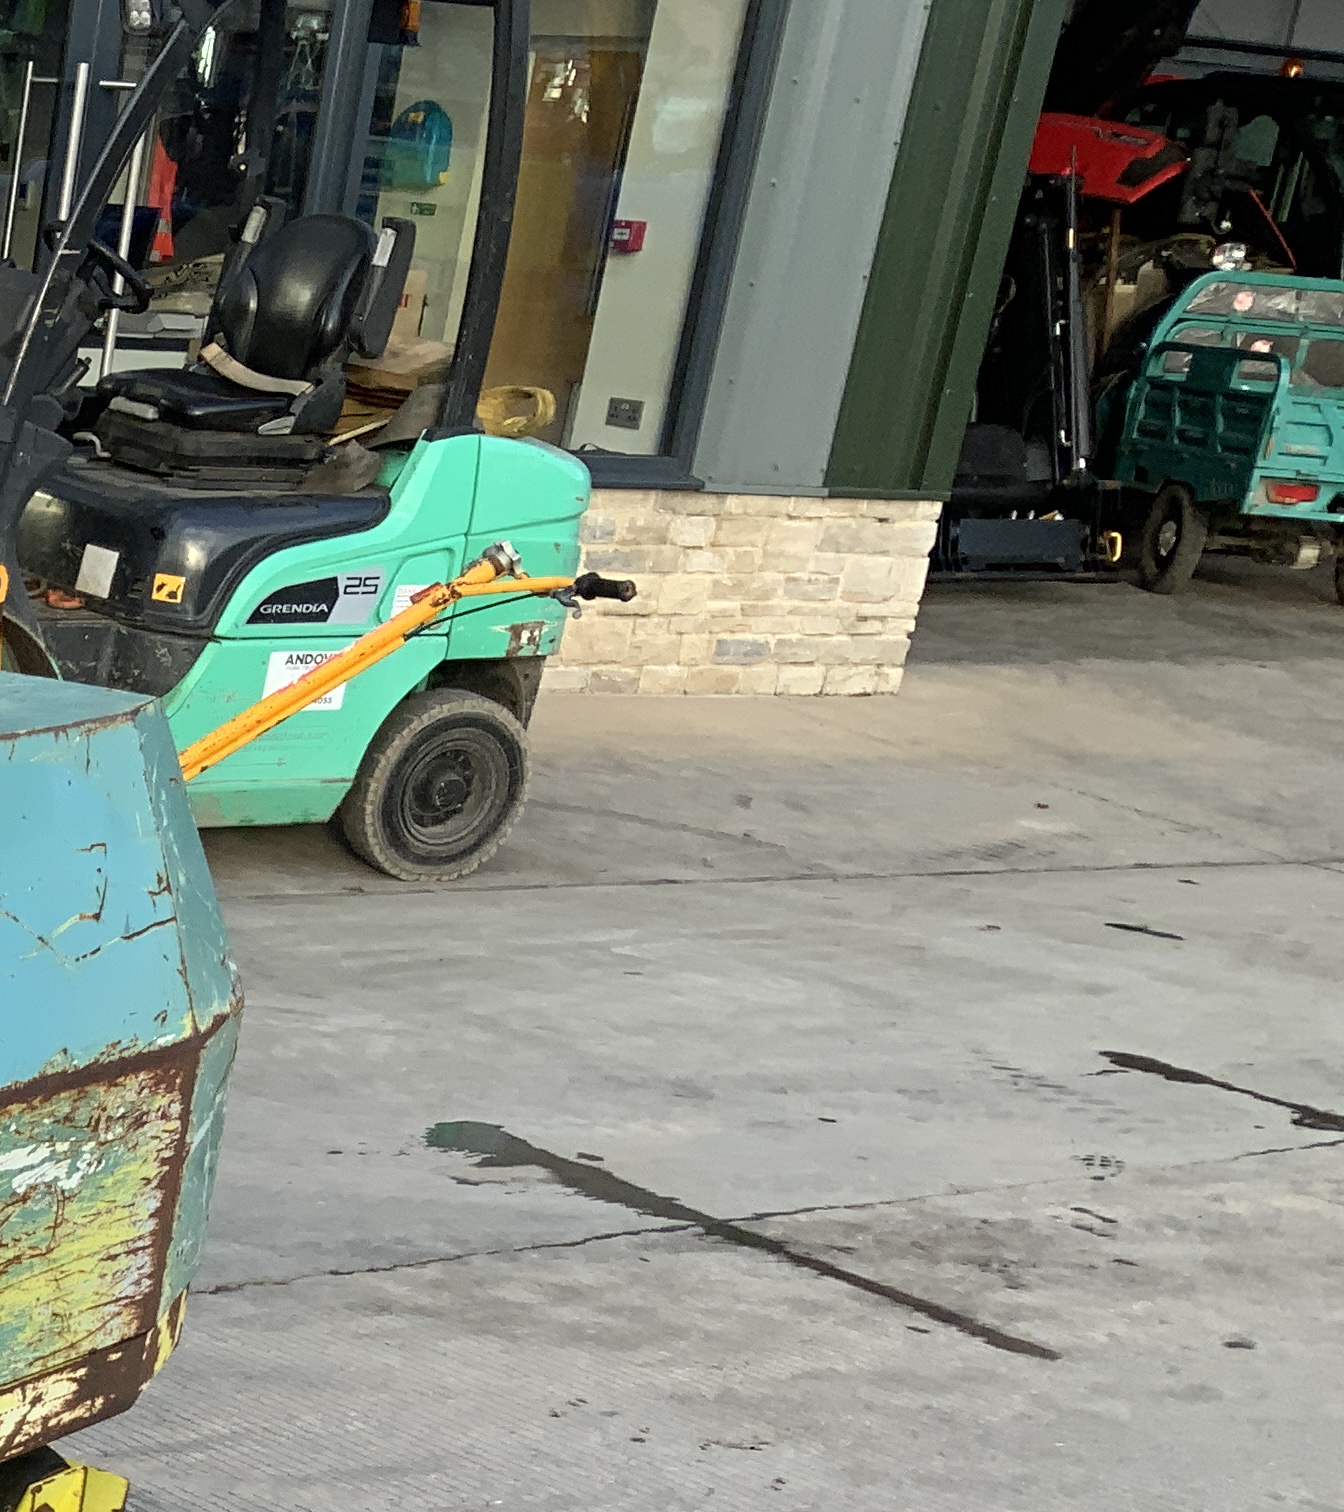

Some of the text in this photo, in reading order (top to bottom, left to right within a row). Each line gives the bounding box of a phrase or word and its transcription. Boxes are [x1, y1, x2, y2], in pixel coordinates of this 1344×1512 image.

[343, 576, 381, 595] 25
[259, 603, 329, 614] GRENDIA
[284, 653, 334, 665] ANDO
